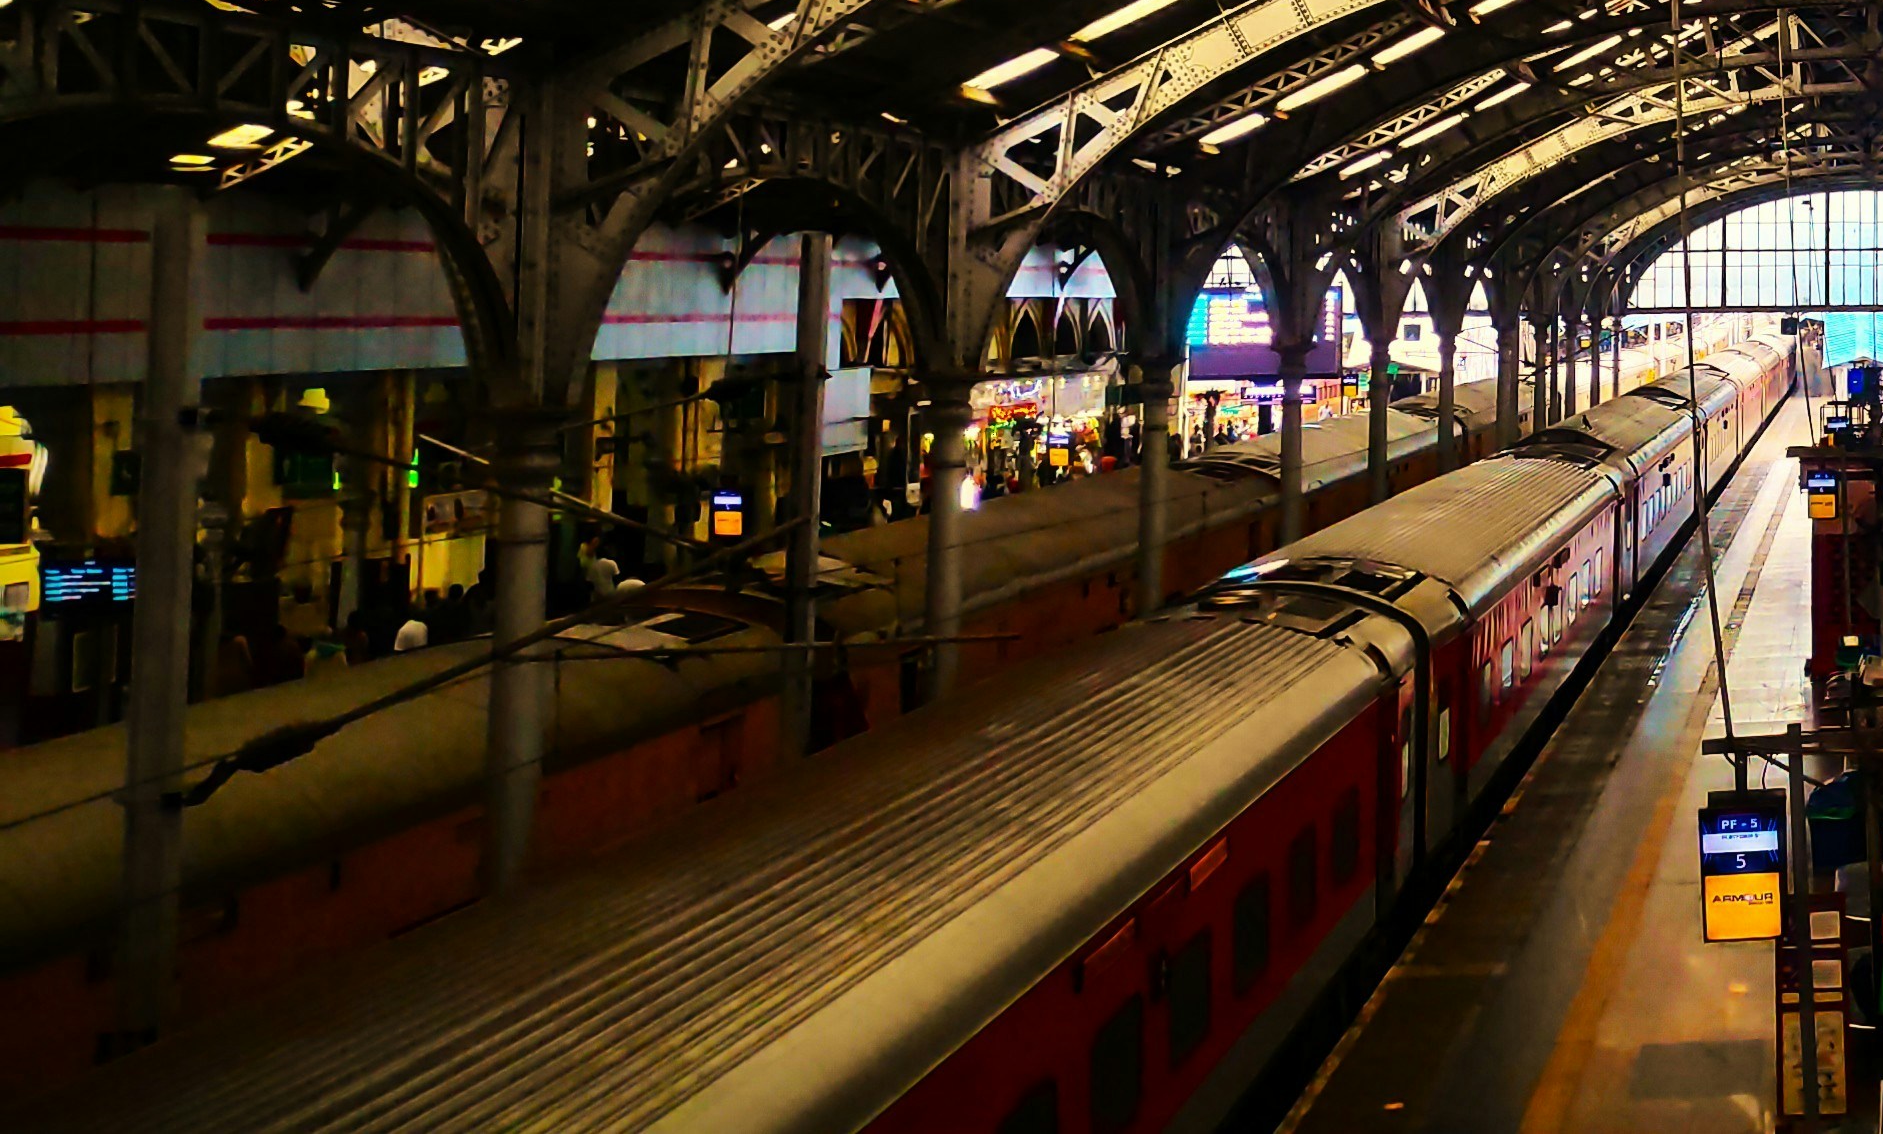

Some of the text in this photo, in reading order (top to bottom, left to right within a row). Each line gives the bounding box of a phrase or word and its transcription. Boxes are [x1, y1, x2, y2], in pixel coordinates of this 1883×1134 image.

[1722, 820, 1738, 830] PF
[1750, 818, 1758, 828] 5
[1736, 854, 1747, 869] 5
